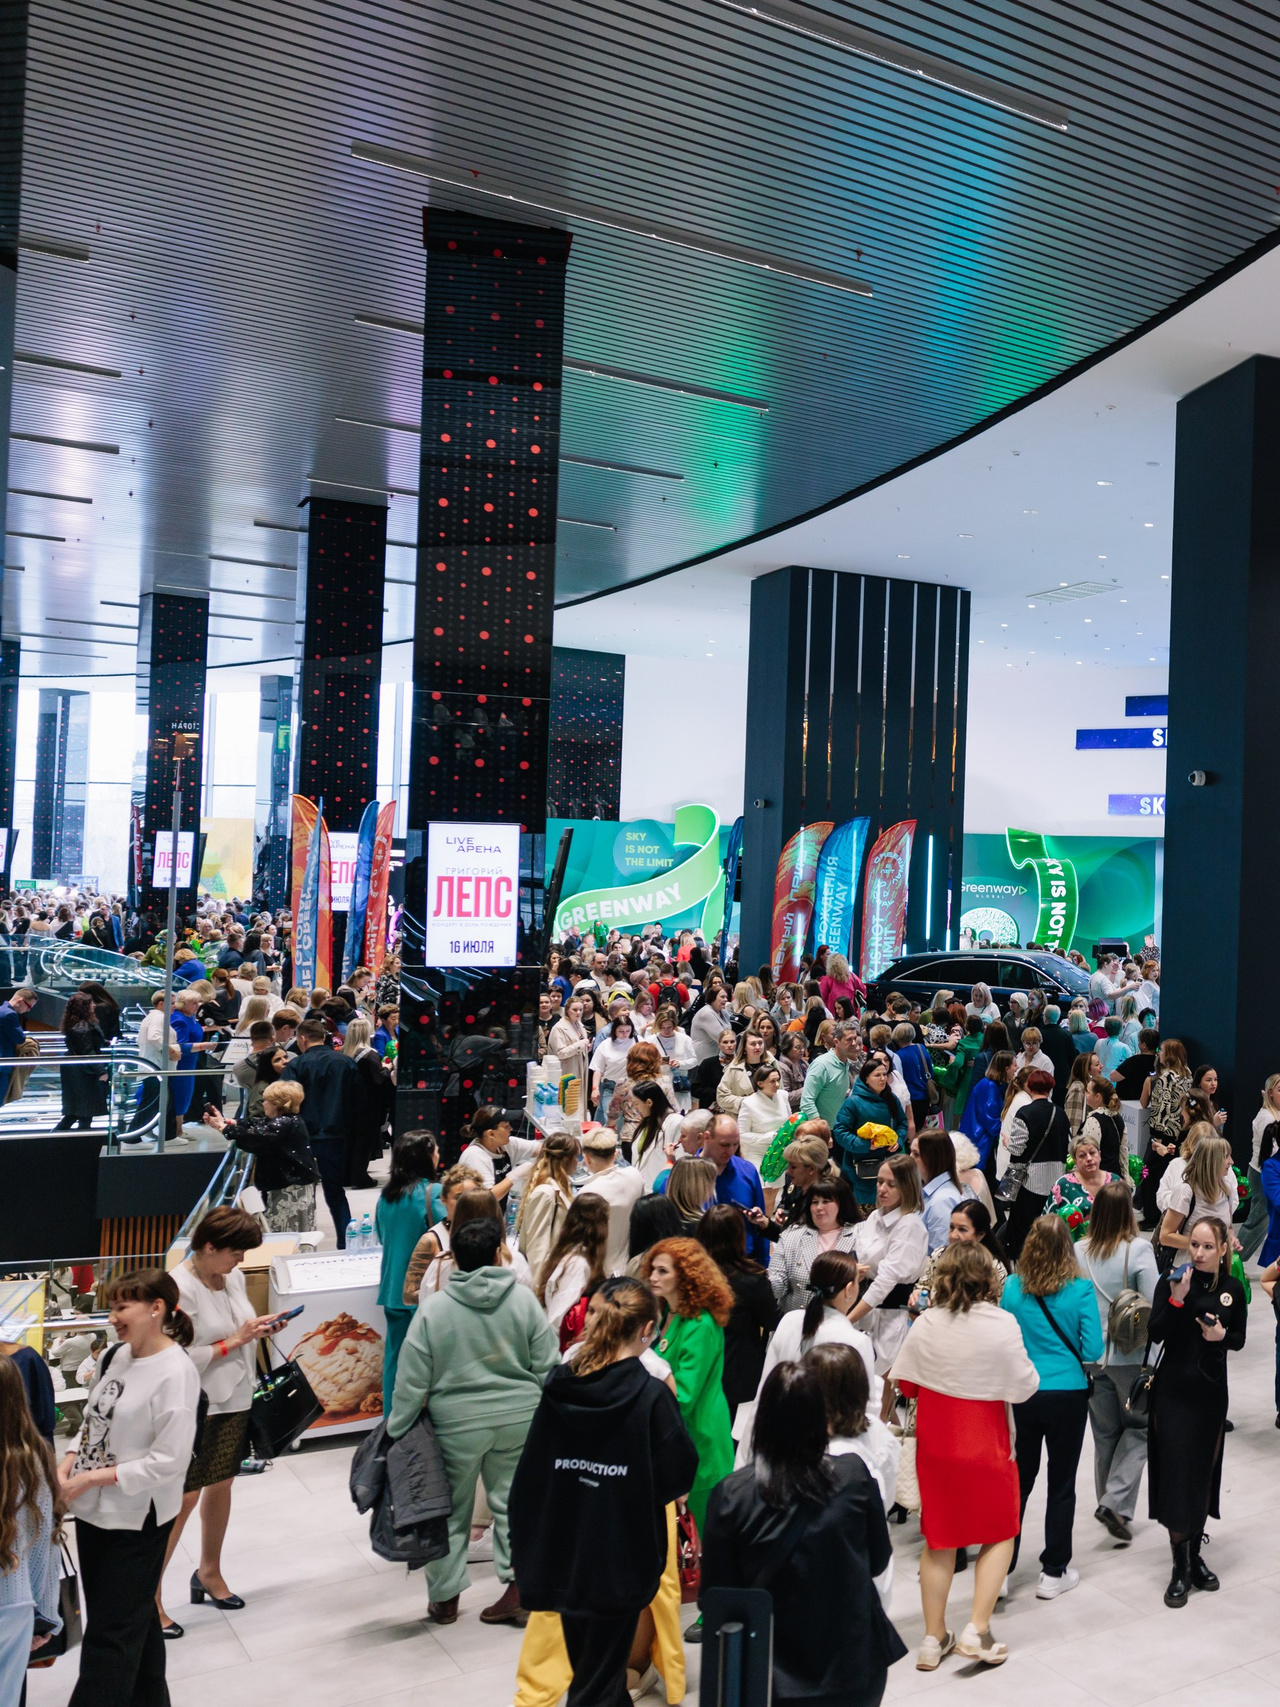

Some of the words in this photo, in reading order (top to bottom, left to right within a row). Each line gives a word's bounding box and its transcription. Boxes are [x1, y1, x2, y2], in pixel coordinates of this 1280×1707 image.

[446, 837, 474, 845] LIVE
[626, 832, 647, 841] SKY
[457, 845, 502, 853] АРЕНА
[625, 845, 635, 853] IS
[638, 845, 660, 854] NOT
[445, 866, 503, 876] ГРИГОРИЙ
[625, 857, 644, 866] THE
[647, 858, 674, 867] LIMIT
[1042, 858, 1065, 877] KY
[432, 875, 513, 918] ЛЕПС
[961, 881, 1019, 896] Greenway
[1050, 880, 1067, 898] IS
[560, 882, 682, 929] GREENWAY
[817, 856, 839, 945] РОЖДЕНИЯ
[828, 882, 849, 955] REENWAY
[1047, 902, 1067, 940] NOT
[449, 940, 461, 954] 16
[463, 940, 495, 954] ИЮЛЯ
[772, 912, 795, 982] АВНЫЙ
[555, 1458, 628, 1476] PRODUCTION
